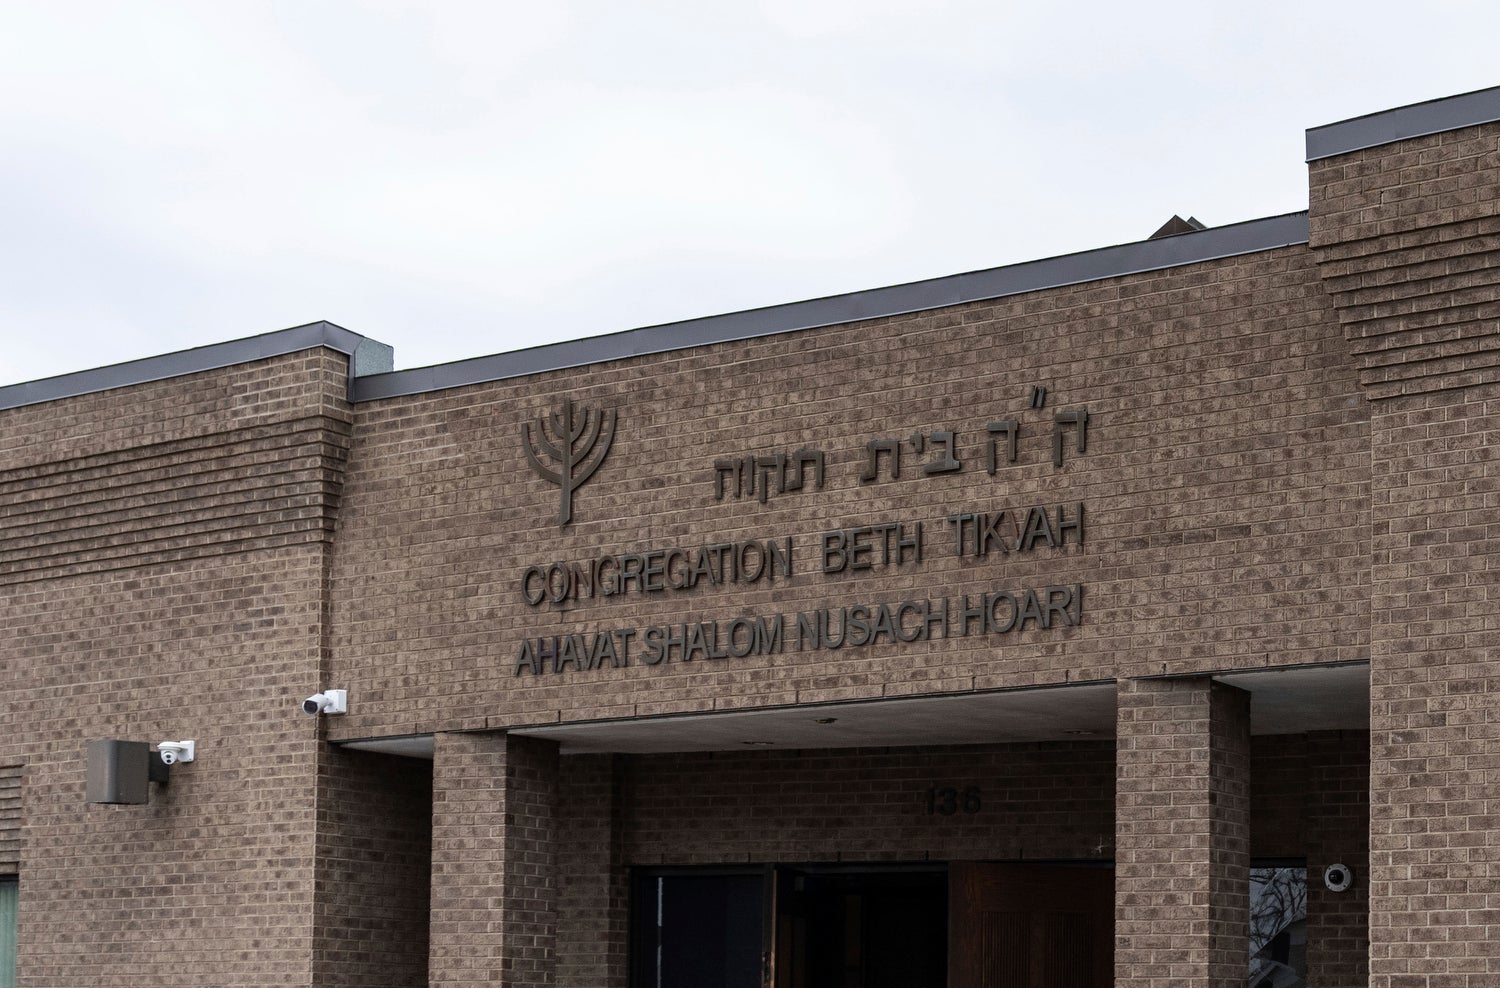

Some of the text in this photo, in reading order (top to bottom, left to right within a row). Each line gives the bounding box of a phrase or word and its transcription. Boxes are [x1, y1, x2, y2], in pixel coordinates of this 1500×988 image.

[714, 449, 823, 503] תקוה
[860, 431, 960, 481] בית
[521, 502, 1083, 605] CONGREGATION BETH TIKVAH
[514, 584, 1081, 676] AHAVAT SHALOM NUSACH HOARI
